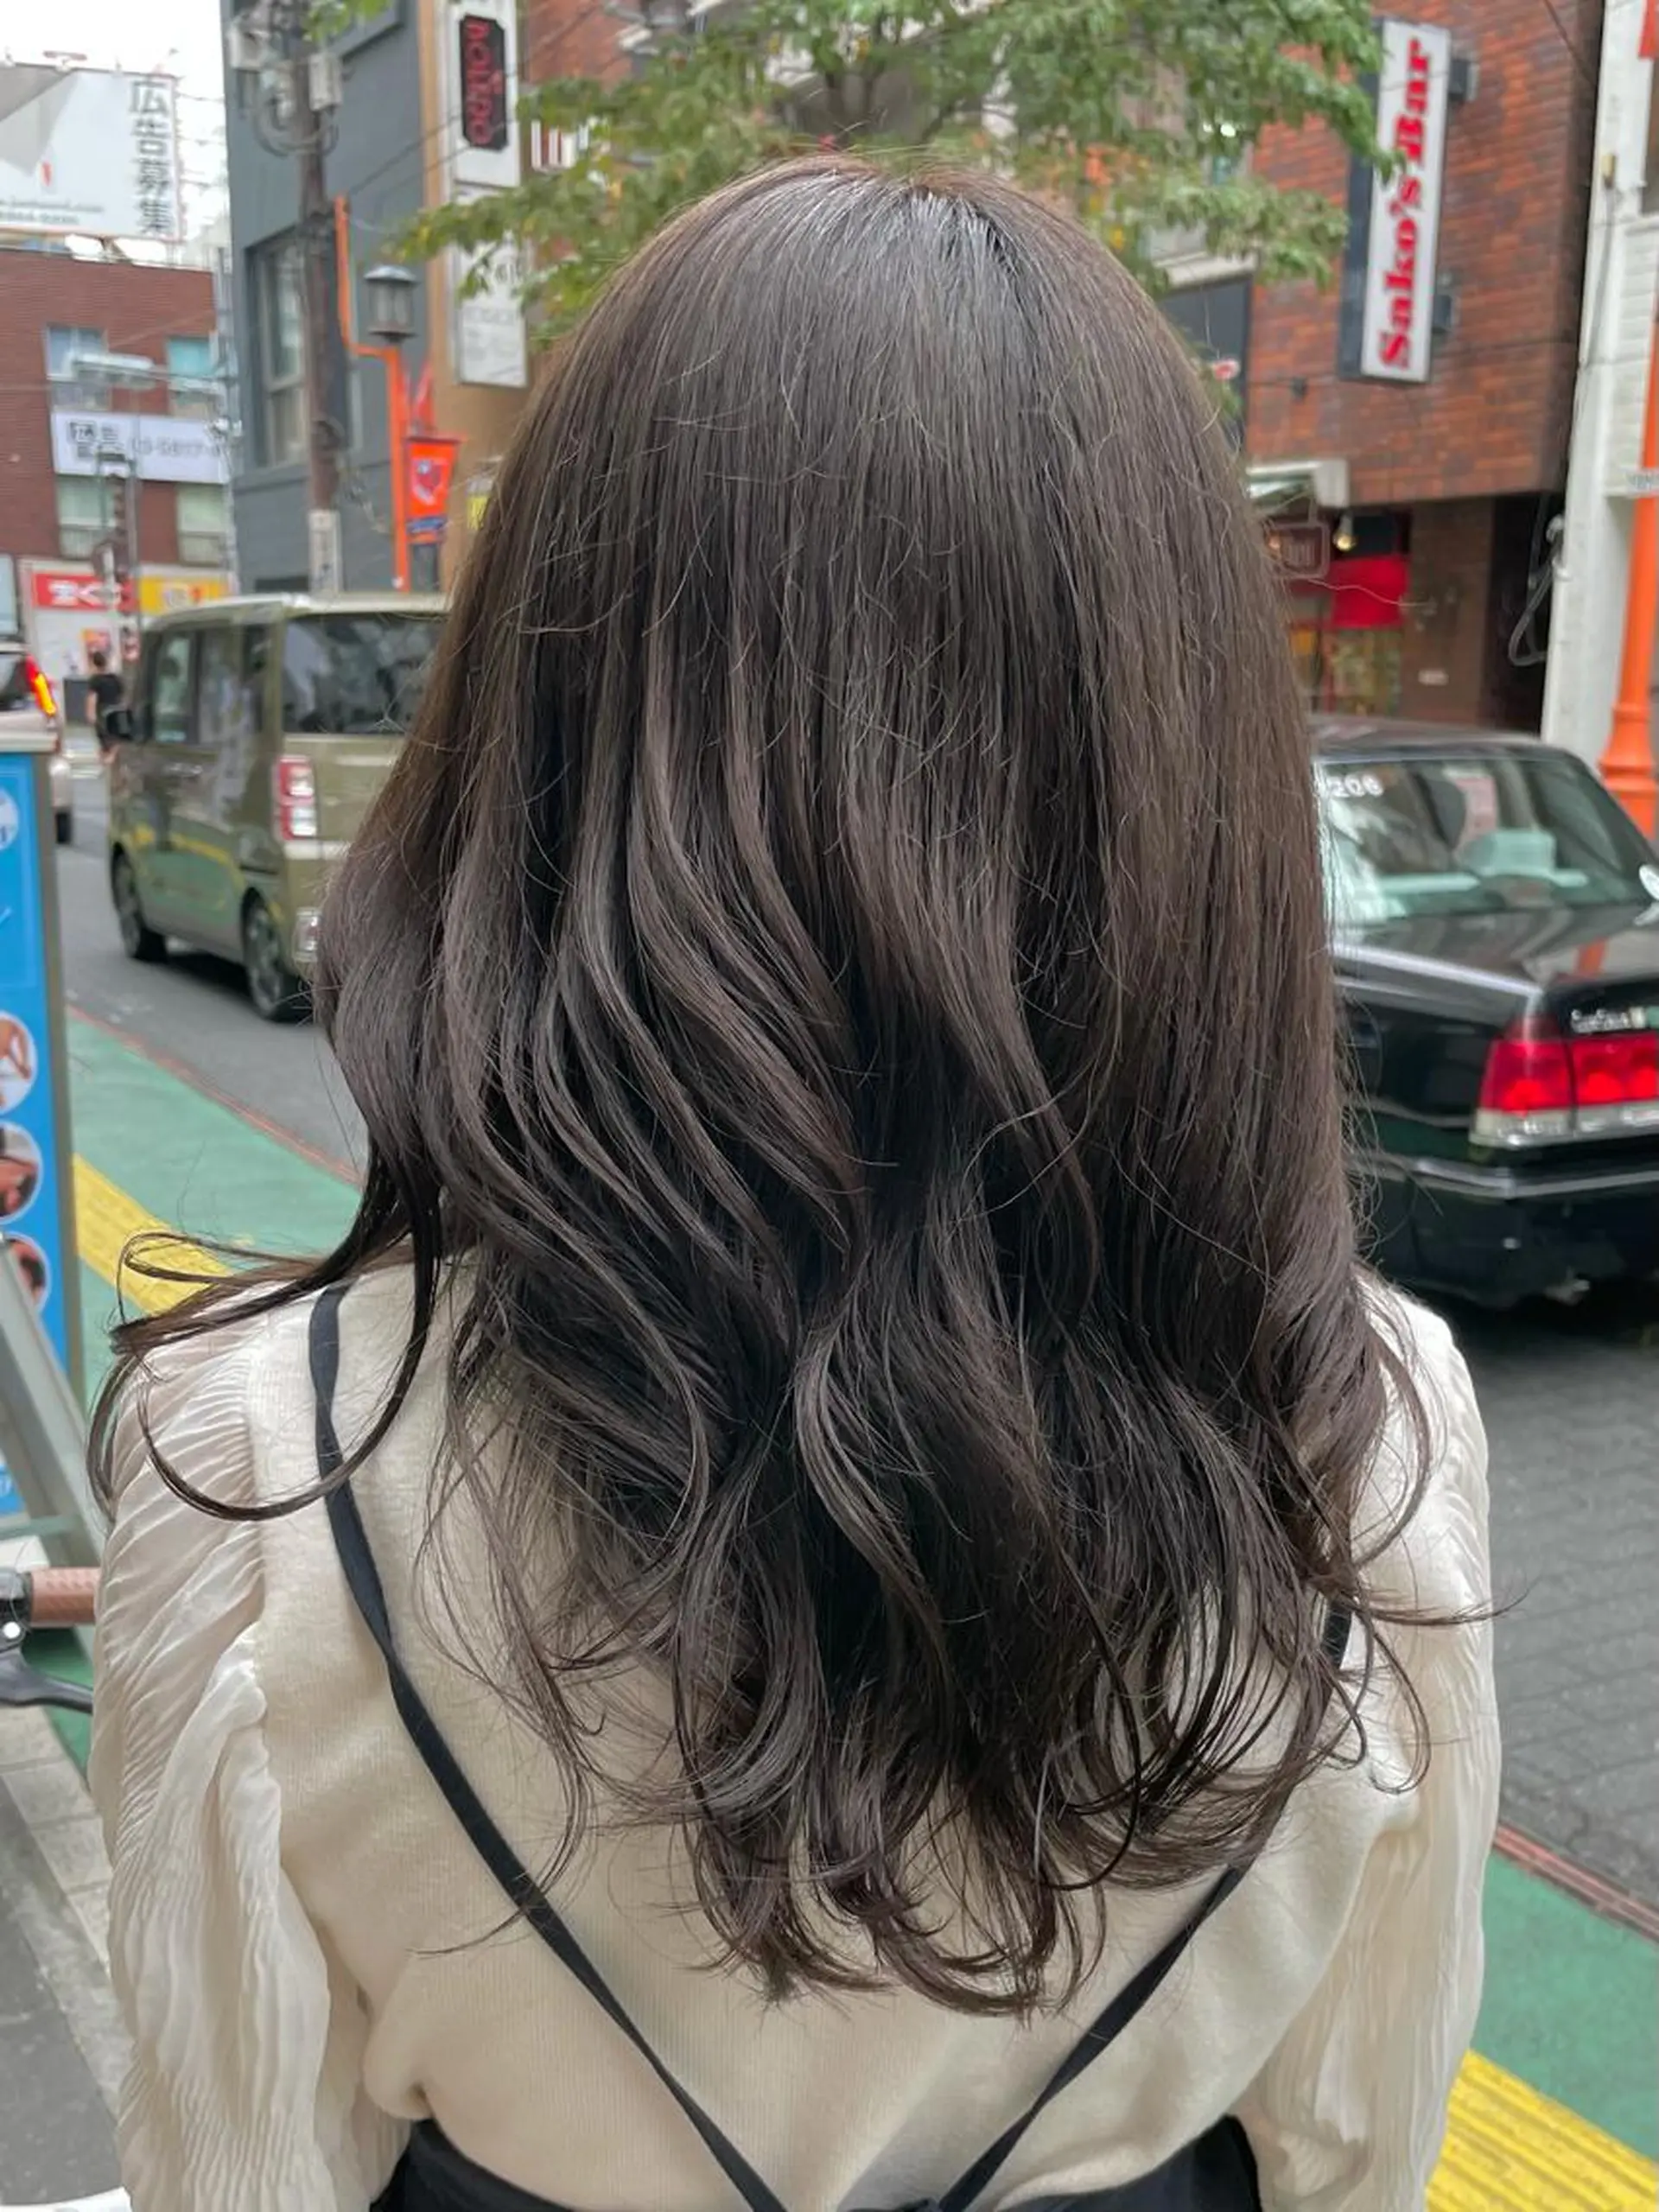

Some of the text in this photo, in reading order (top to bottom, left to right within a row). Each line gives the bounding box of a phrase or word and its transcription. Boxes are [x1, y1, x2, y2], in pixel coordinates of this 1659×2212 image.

[130, 74, 173, 236] 広告募集
[1379, 37, 1429, 369] Sako's Bar
